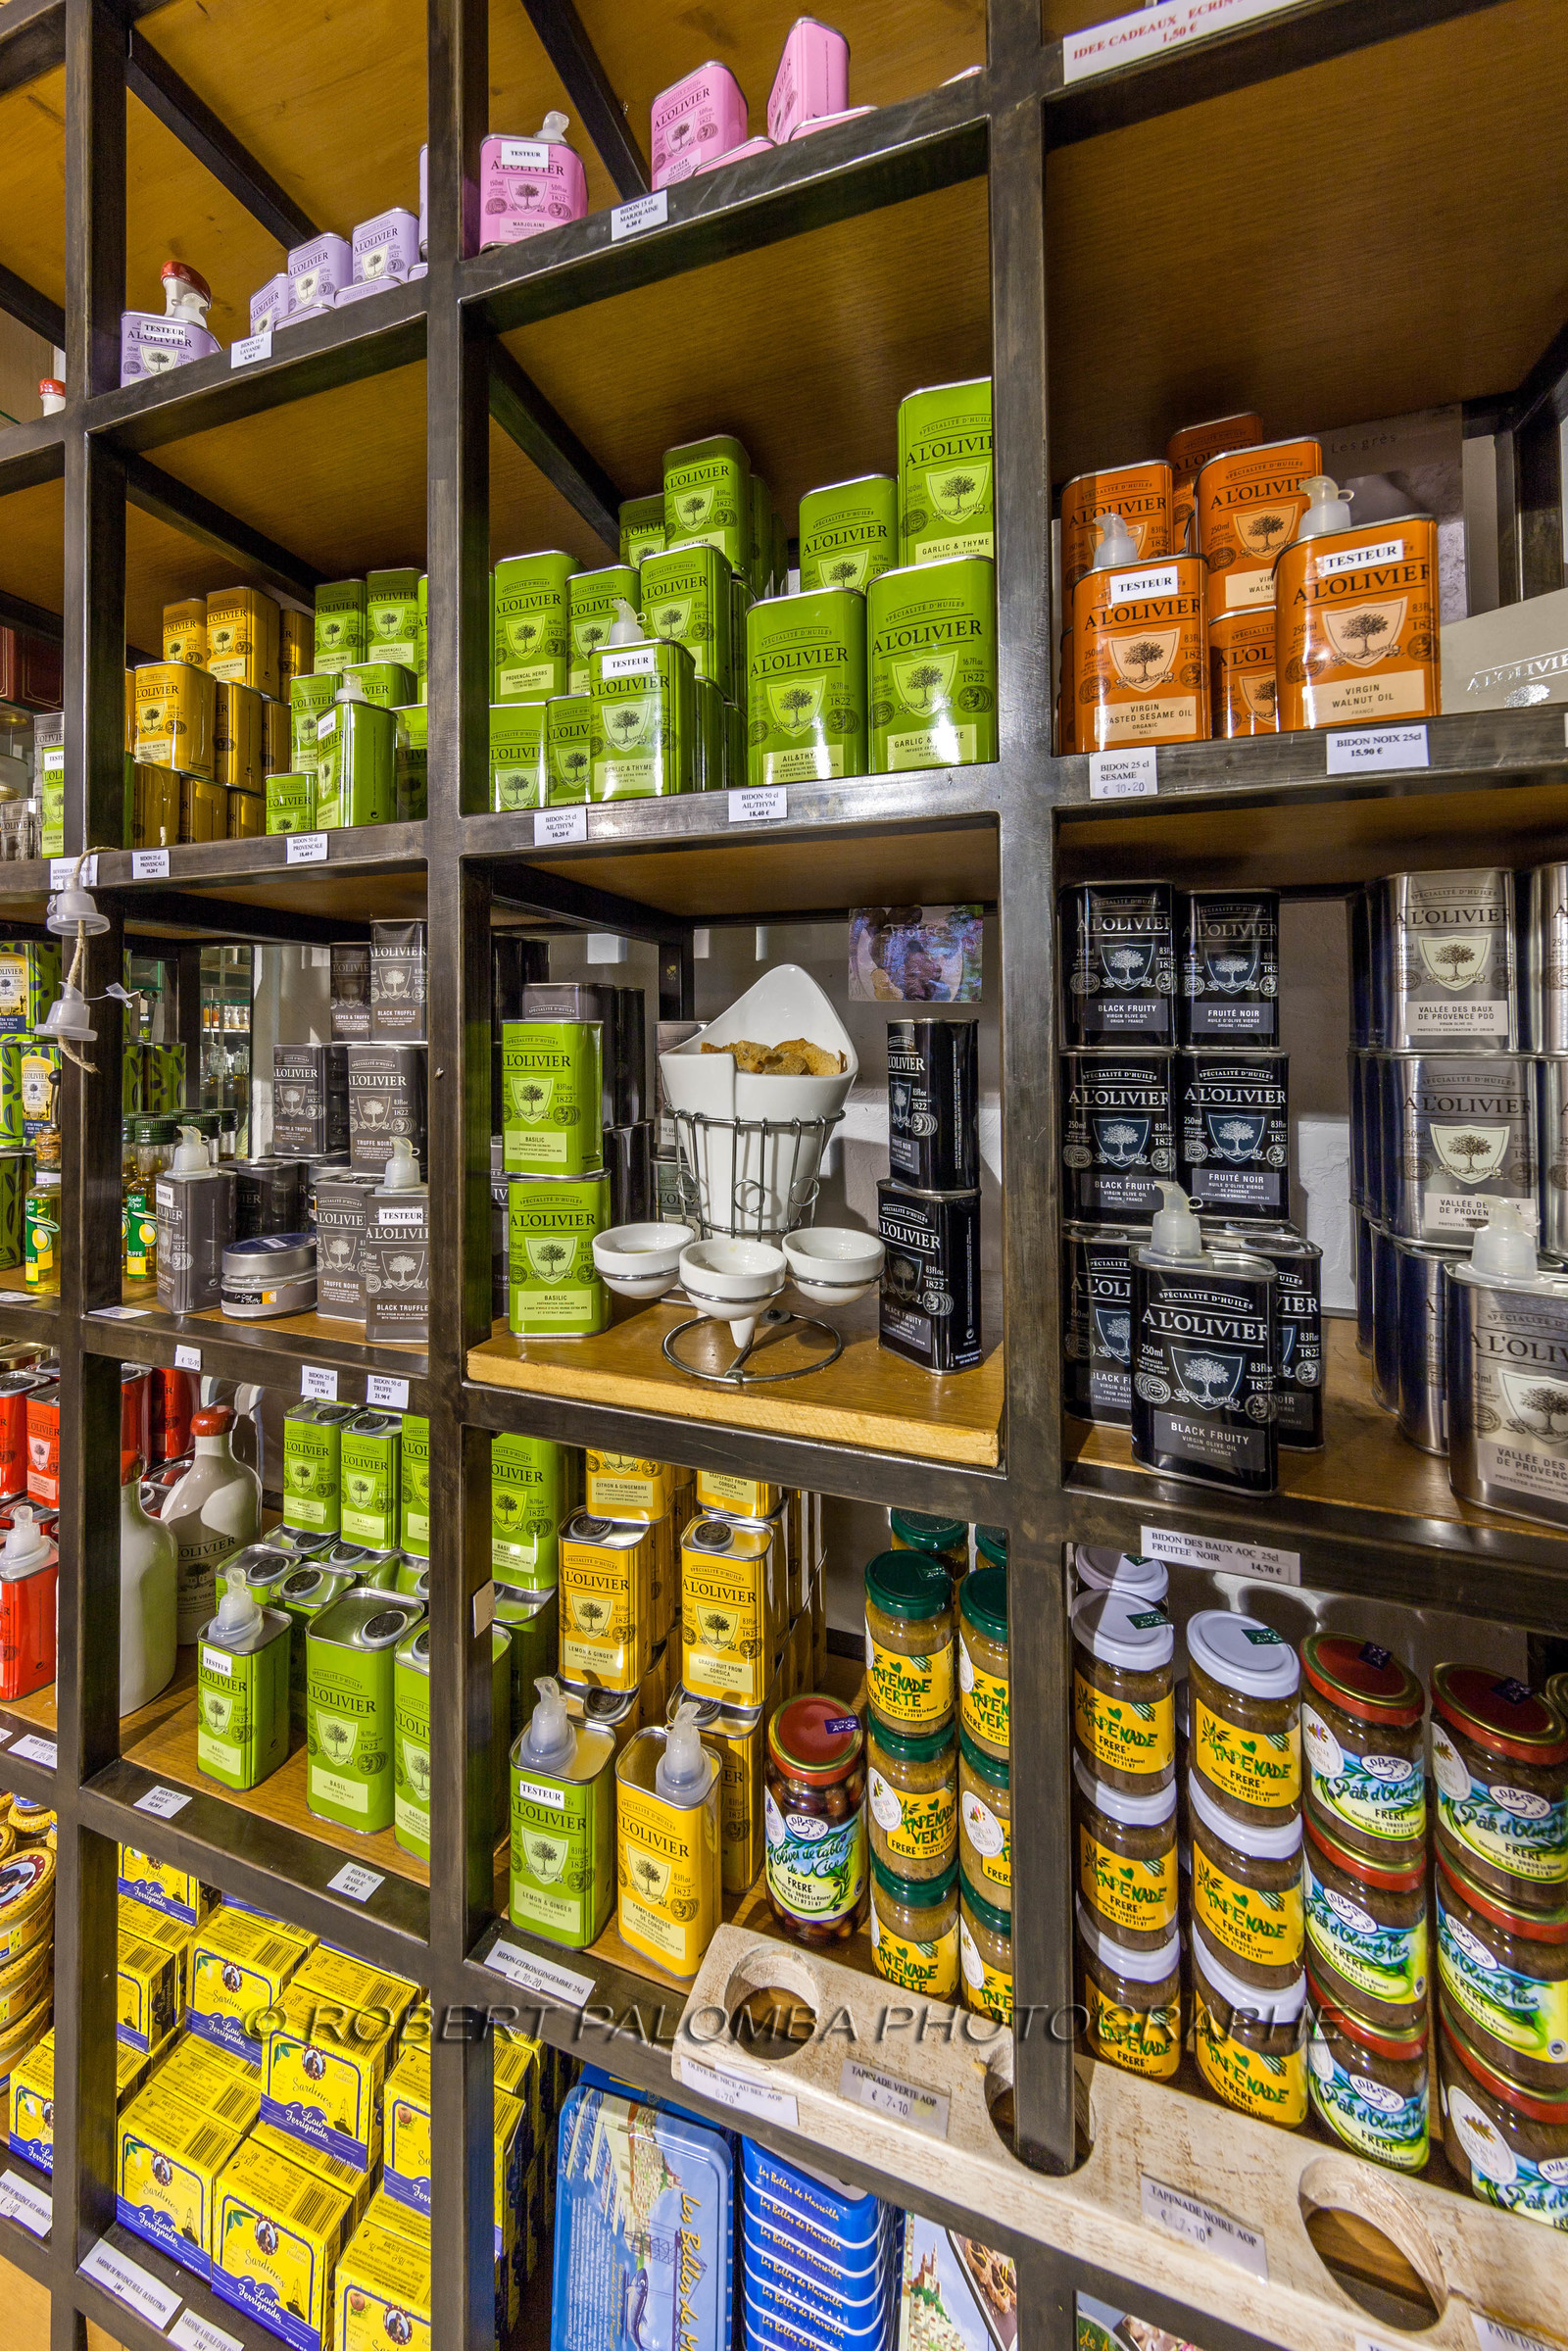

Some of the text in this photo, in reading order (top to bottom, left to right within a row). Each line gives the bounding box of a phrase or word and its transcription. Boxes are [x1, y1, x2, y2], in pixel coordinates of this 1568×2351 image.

[1073, 41, 1105, 60] IDEE
[1108, 15, 1177, 47] CADEAUX
[620, 204, 640, 215] BIDON
[620, 205, 658, 222] MARJOLAINE
[145, 324, 184, 335] TESTEUR
[1331, 441, 1357, 455] Les
[670, 465, 729, 488] L'OLIVIER
[922, 542, 951, 555] GARLIC
[962, 538, 990, 548] THYME
[1327, 546, 1396, 568] TESTEUR
[652, 576, 709, 597] L'OLIVIER
[1118, 577, 1172, 593] TESTEUR
[1293, 564, 1429, 605] A L'OLIVIER
[1084, 598, 1200, 631] A L'OLIVIER
[886, 620, 982, 650] L'OLIVIER
[612, 657, 649, 668] TESTEUR
[598, 676, 669, 695] L'OLIVIER
[962, 673, 985, 682] 1822
[1346, 684, 1380, 695] VIRGIN
[830, 697, 851, 707] 1822
[1131, 703, 1159, 713] VIRGIN
[1333, 693, 1394, 708] WALNUT OIL
[1140, 710, 1174, 721] SESAME
[1178, 708, 1192, 718] OIL
[1337, 733, 1421, 748] BIDON NOIX 25cl
[1350, 747, 1383, 757] 15.90 €
[1101, 762, 1129, 771] BIDON
[1101, 771, 1137, 781] SESAME
[1208, 1007, 1232, 1017] FRUITÉ
[508, 1054, 570, 1067] L'OLIVIER
[353, 1076, 407, 1086] L'OLIVIER
[1200, 1087, 1286, 1103] L'OLIVIER
[1158, 1292, 1253, 1309] SPÉCIALITÉ D'HUILES
[1142, 1309, 1267, 1341] A L'OLIVIER
[1142, 1344, 1163, 1357] 250ml
[1171, 1422, 1250, 1445] BLACK FRUITY
[1183, 1437, 1203, 1445] VIRGIN
[1211, 1448, 1232, 1457] FRANCE
[1152, 1533, 1279, 1562] BIDON DES BAUX AOC 25cl
[1152, 1543, 1220, 1561] FRUITEE NOIR
[565, 1571, 629, 1590] L'OLIVIER
[568, 1645, 586, 1655] LEMON
[593, 1651, 613, 1660] GINGER
[699, 1658, 726, 1670] GRAPEFRUIT
[710, 1668, 730, 1677] CORSICA
[872, 1666, 932, 1693] TAPENADE
[312, 1690, 376, 1713] L'OLIVIER
[877, 1684, 921, 1707] VERTE
[1100, 1735, 1126, 1754] FRERE
[1210, 1742, 1292, 1780] TAPENADE
[330, 1780, 347, 1791] BASIL
[1230, 1770, 1261, 1788] FRERE
[521, 1785, 562, 1801] TESTEUR
[621, 1816, 689, 1857] L'OLIVIER
[673, 1887, 691, 1896] 1822
[788, 1877, 812, 1892] FRERE
[1096, 1869, 1166, 1903] TAPENADE
[632, 1902, 671, 1930] PAMPLEMOUSSE
[1205, 1887, 1288, 1938] TAPENADE
[640, 1913, 662, 1933] DE CORSE
[497, 1951, 515, 1963] BIDON
[688, 2061, 782, 2102] OLIVE DE NICE AU SEL AOP
[852, 2065, 937, 2107] TAPENADE VERTE AOP
[293, 2077, 334, 2110] Sardines
[301, 2110, 324, 2129] Lou
[760, 2165, 769, 2180] Les
[770, 2171, 793, 2193] Belles
[804, 2192, 840, 2222] Marseille
[681, 2193, 702, 2225] Les
[1151, 2184, 1256, 2247] TAPENADE NOIRE AOP
[760, 2195, 770, 2210] Les
[772, 2201, 794, 2224] Belles
[806, 2223, 841, 2252] Marseille
[680, 2227, 702, 2303] Belles
